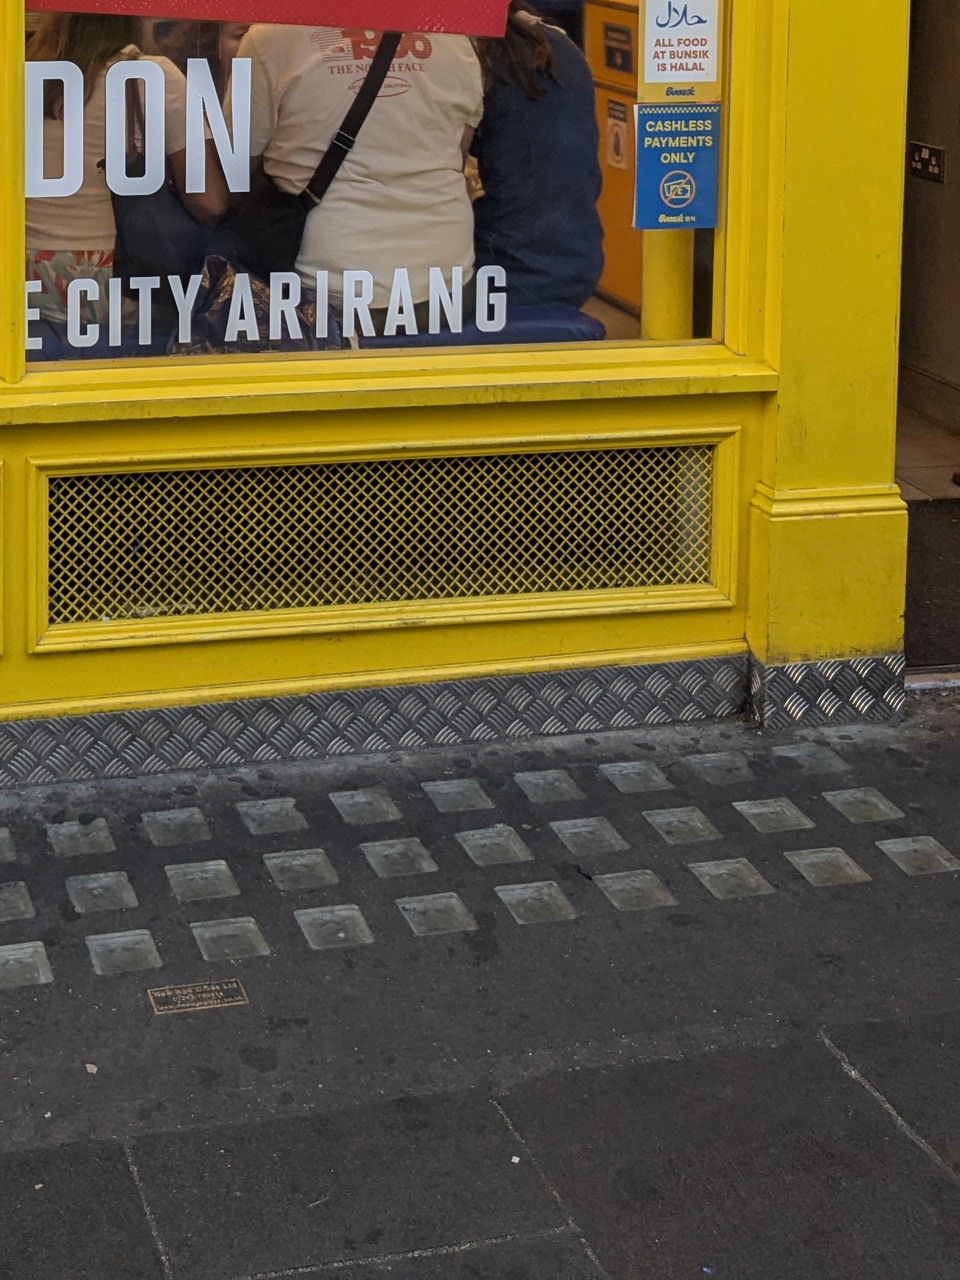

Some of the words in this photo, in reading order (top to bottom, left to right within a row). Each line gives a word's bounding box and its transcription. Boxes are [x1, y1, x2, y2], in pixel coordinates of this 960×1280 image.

[655, 0, 708, 28] حلال
[654, 38, 674, 47] ALL
[677, 37, 708, 47] FOOD
[652, 51, 666, 60] AT
[669, 50, 709, 59] BUNSIK
[327, 64, 353, 75] THE
[398, 62, 426, 73] FACE
[657, 63, 667, 72] IS
[670, 62, 705, 72] HALAL
[645, 120, 713, 132] CASHLESS
[644, 136, 713, 148] PAYMENTS
[660, 152, 696, 163] ONLY
[67, 274, 203, 348] CITY
[224, 265, 508, 342] ARIRANG
